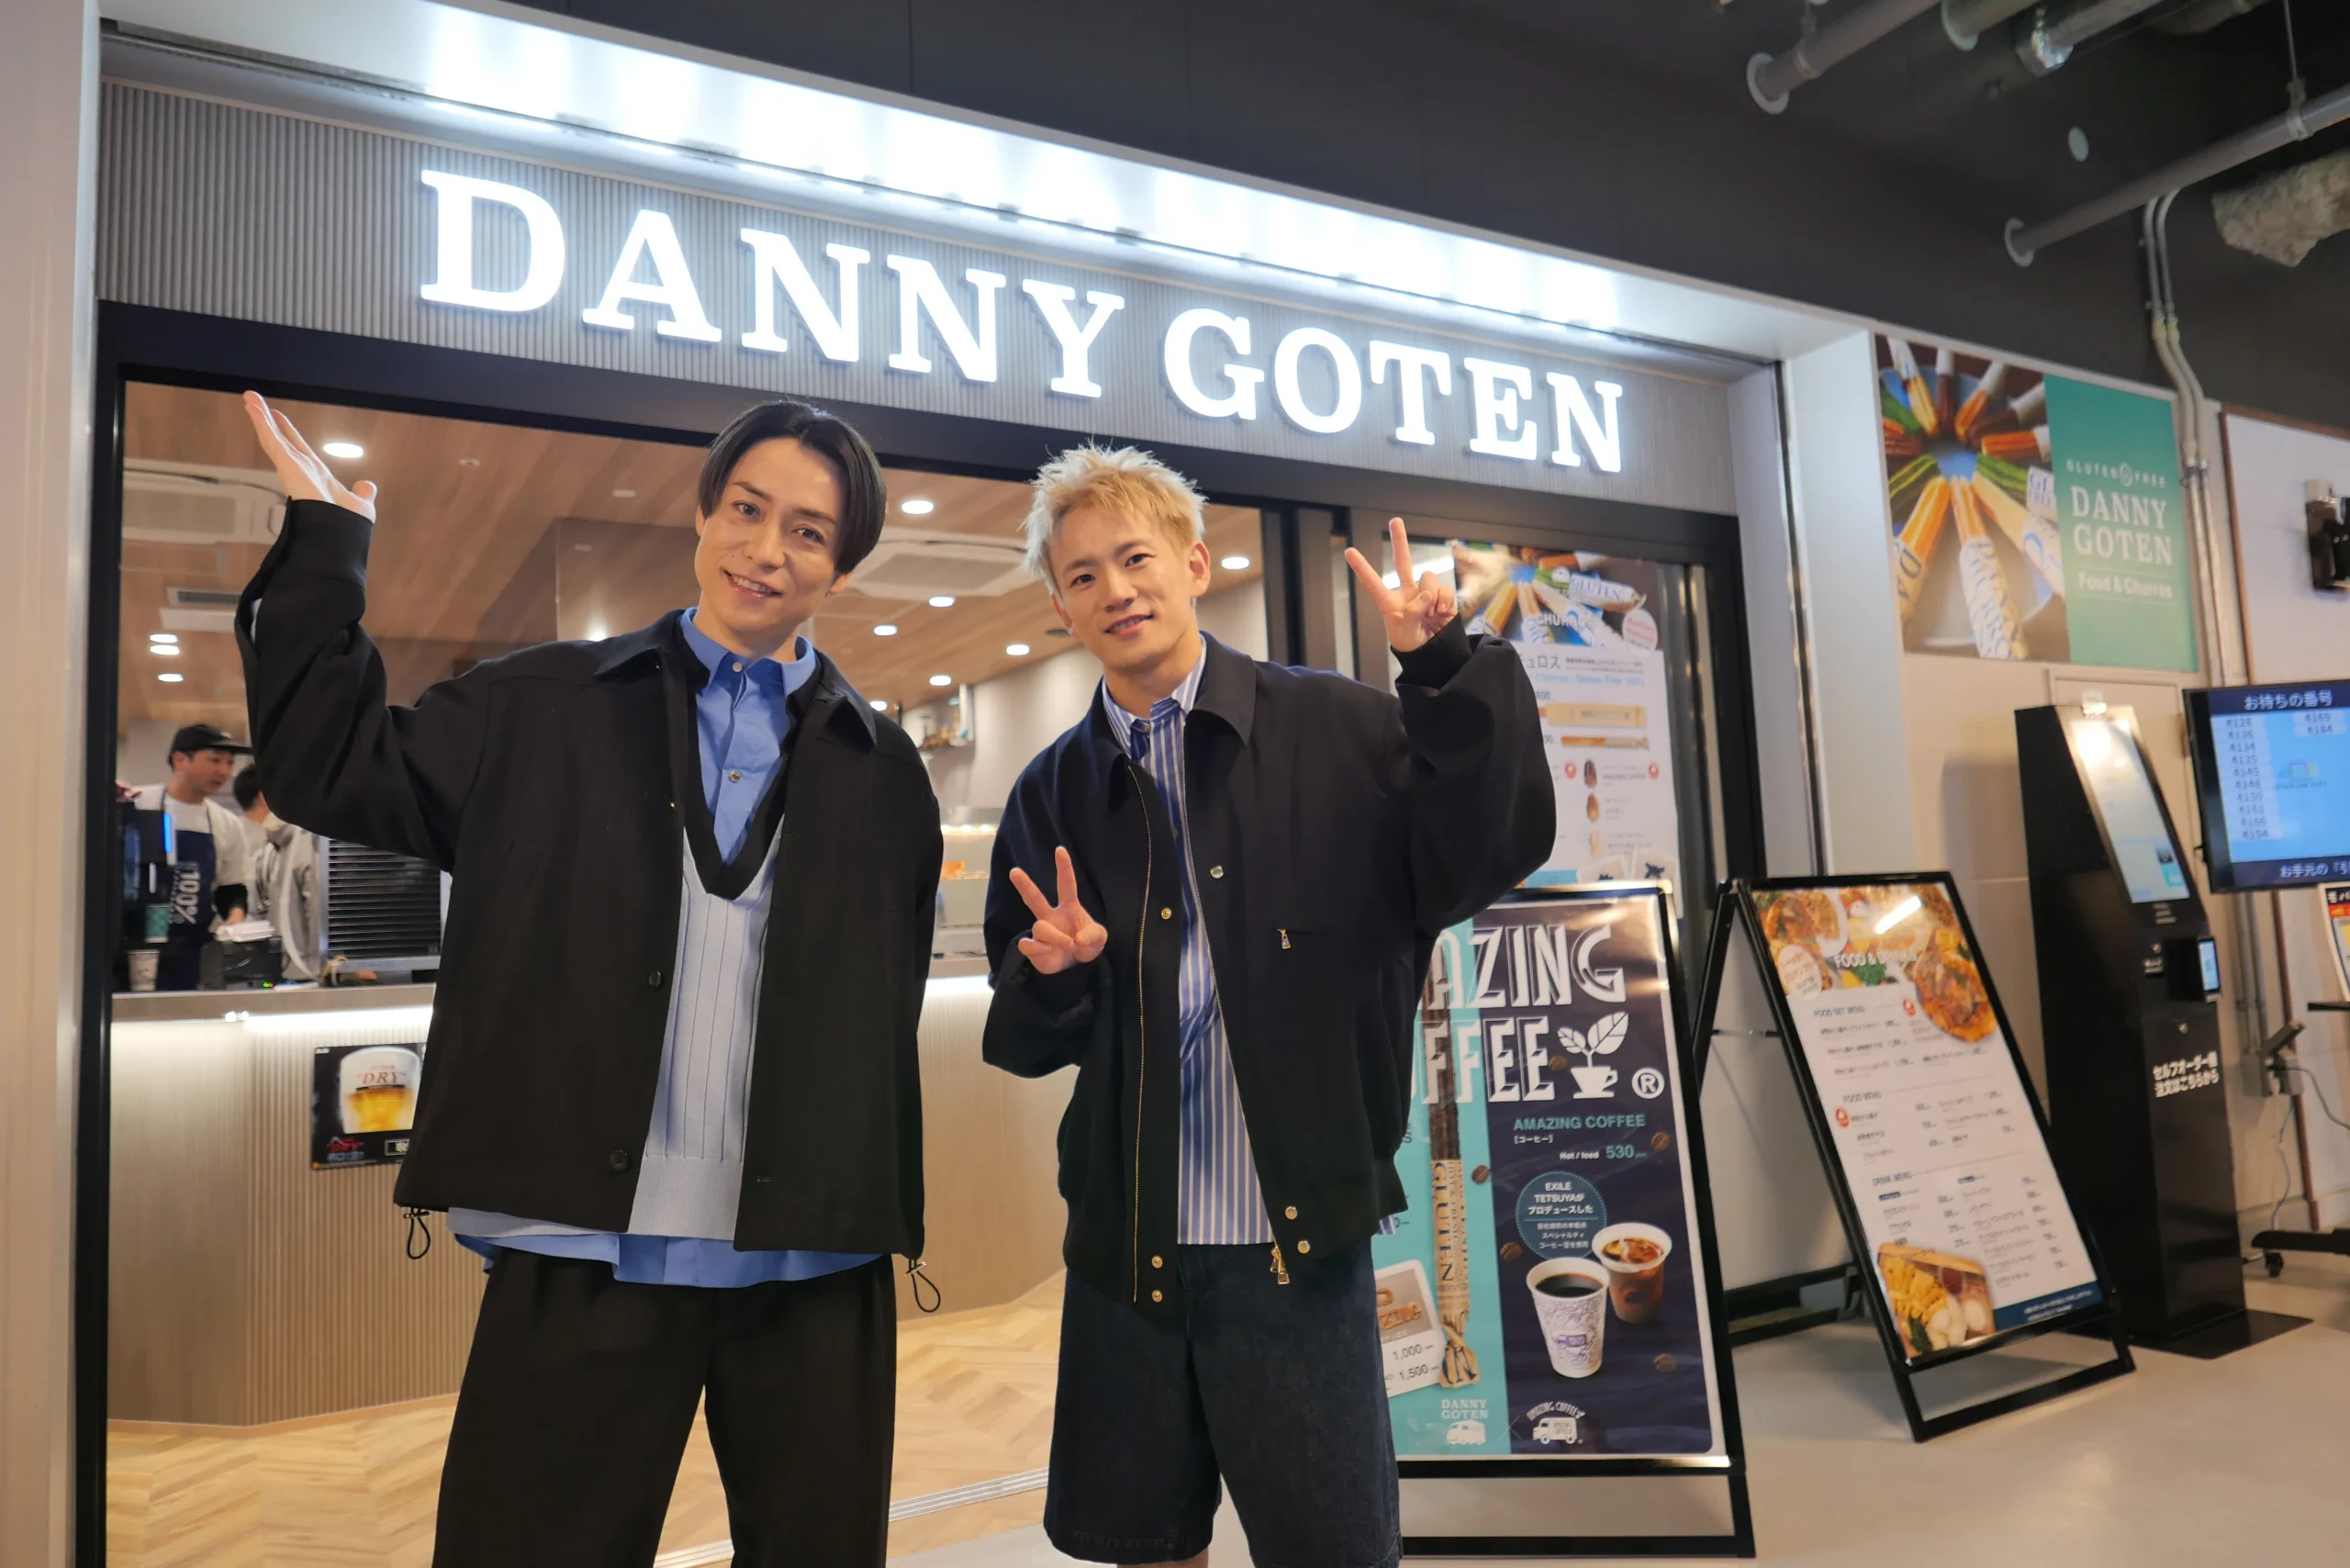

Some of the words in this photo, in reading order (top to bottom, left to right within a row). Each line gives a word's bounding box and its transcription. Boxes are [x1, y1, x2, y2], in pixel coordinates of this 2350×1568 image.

[420, 170, 1125, 398] DANNY
[1164, 308, 1623, 473] GOTEN
[2066, 459, 2118, 479] GLUTEN
[2134, 470, 2165, 487] FREE
[2070, 485, 2167, 530] DANNY
[2073, 522, 2172, 566] GOTEN
[2078, 571, 2110, 592] Food
[2123, 576, 2173, 599] Churros
[2244, 689, 2333, 711] お待ちの番号
[1417, 924, 1627, 1010] AZING
[1834, 952, 1866, 968] FOOD
[1514, 1116, 1582, 1131] AMAZING
[1585, 1114, 1646, 1129] COFFEE
[1606, 1145, 1635, 1159] 530
[1545, 1182, 1572, 1191] EXILE
[1528, 1205, 1594, 1215] プロデュースした
[1392, 1343, 1423, 1361] 1,000
[1398, 1364, 1429, 1382] 1,500
[1441, 1399, 1487, 1409] DANNY
[1441, 1409, 1488, 1419] GOTEN
